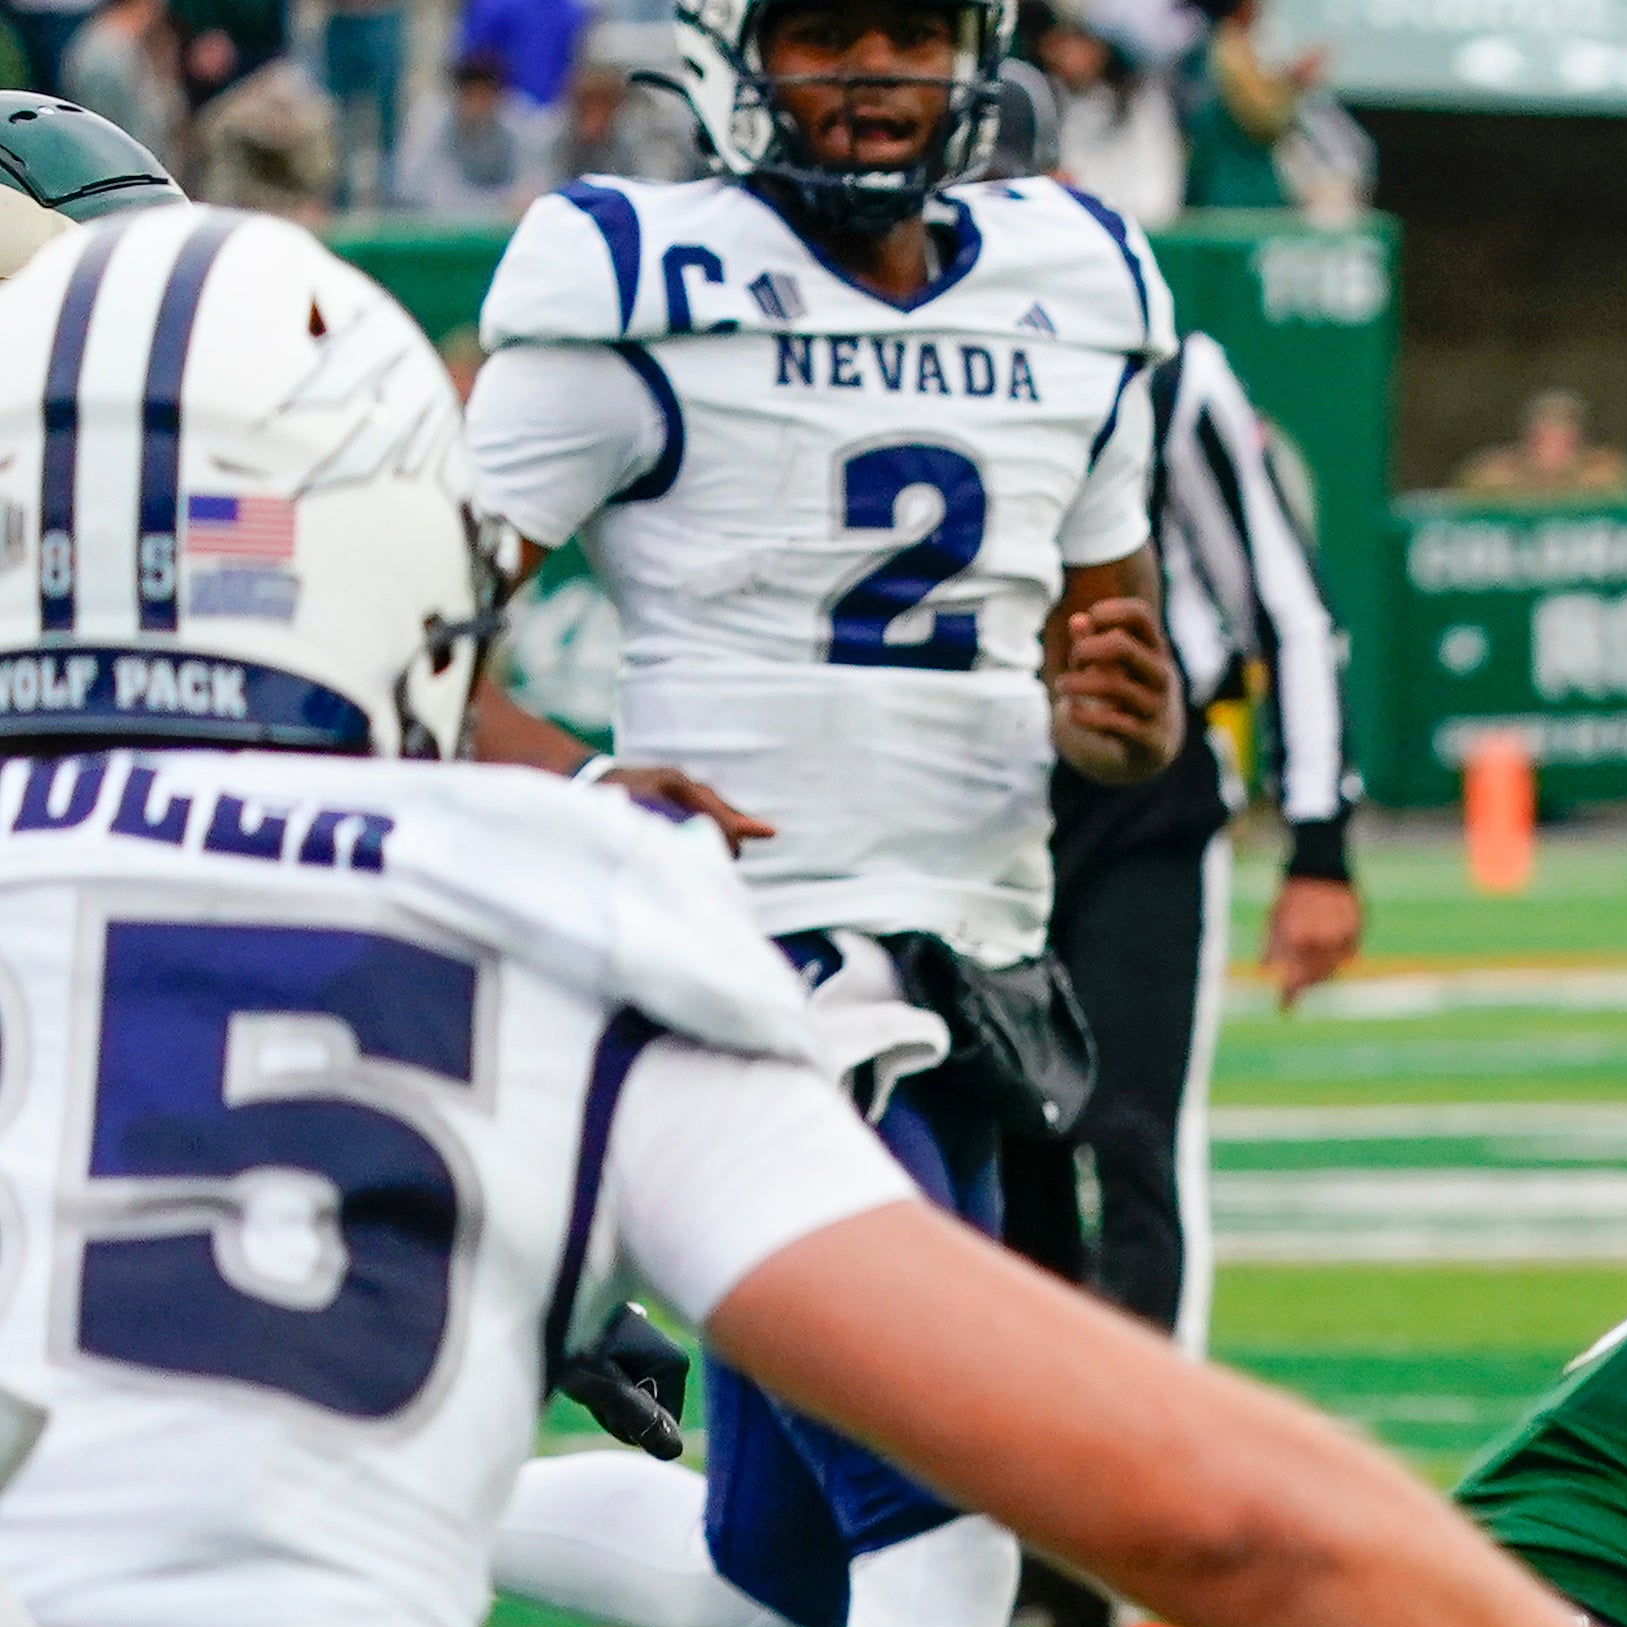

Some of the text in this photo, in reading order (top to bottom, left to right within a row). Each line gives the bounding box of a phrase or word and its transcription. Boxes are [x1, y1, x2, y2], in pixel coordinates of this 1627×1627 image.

[662, 244, 740, 334] C
[775, 333, 1041, 402] NEVADA
[825, 434, 987, 669] 2
[112, 656, 250, 719] PACK
[0, 892, 502, 1438] 5
